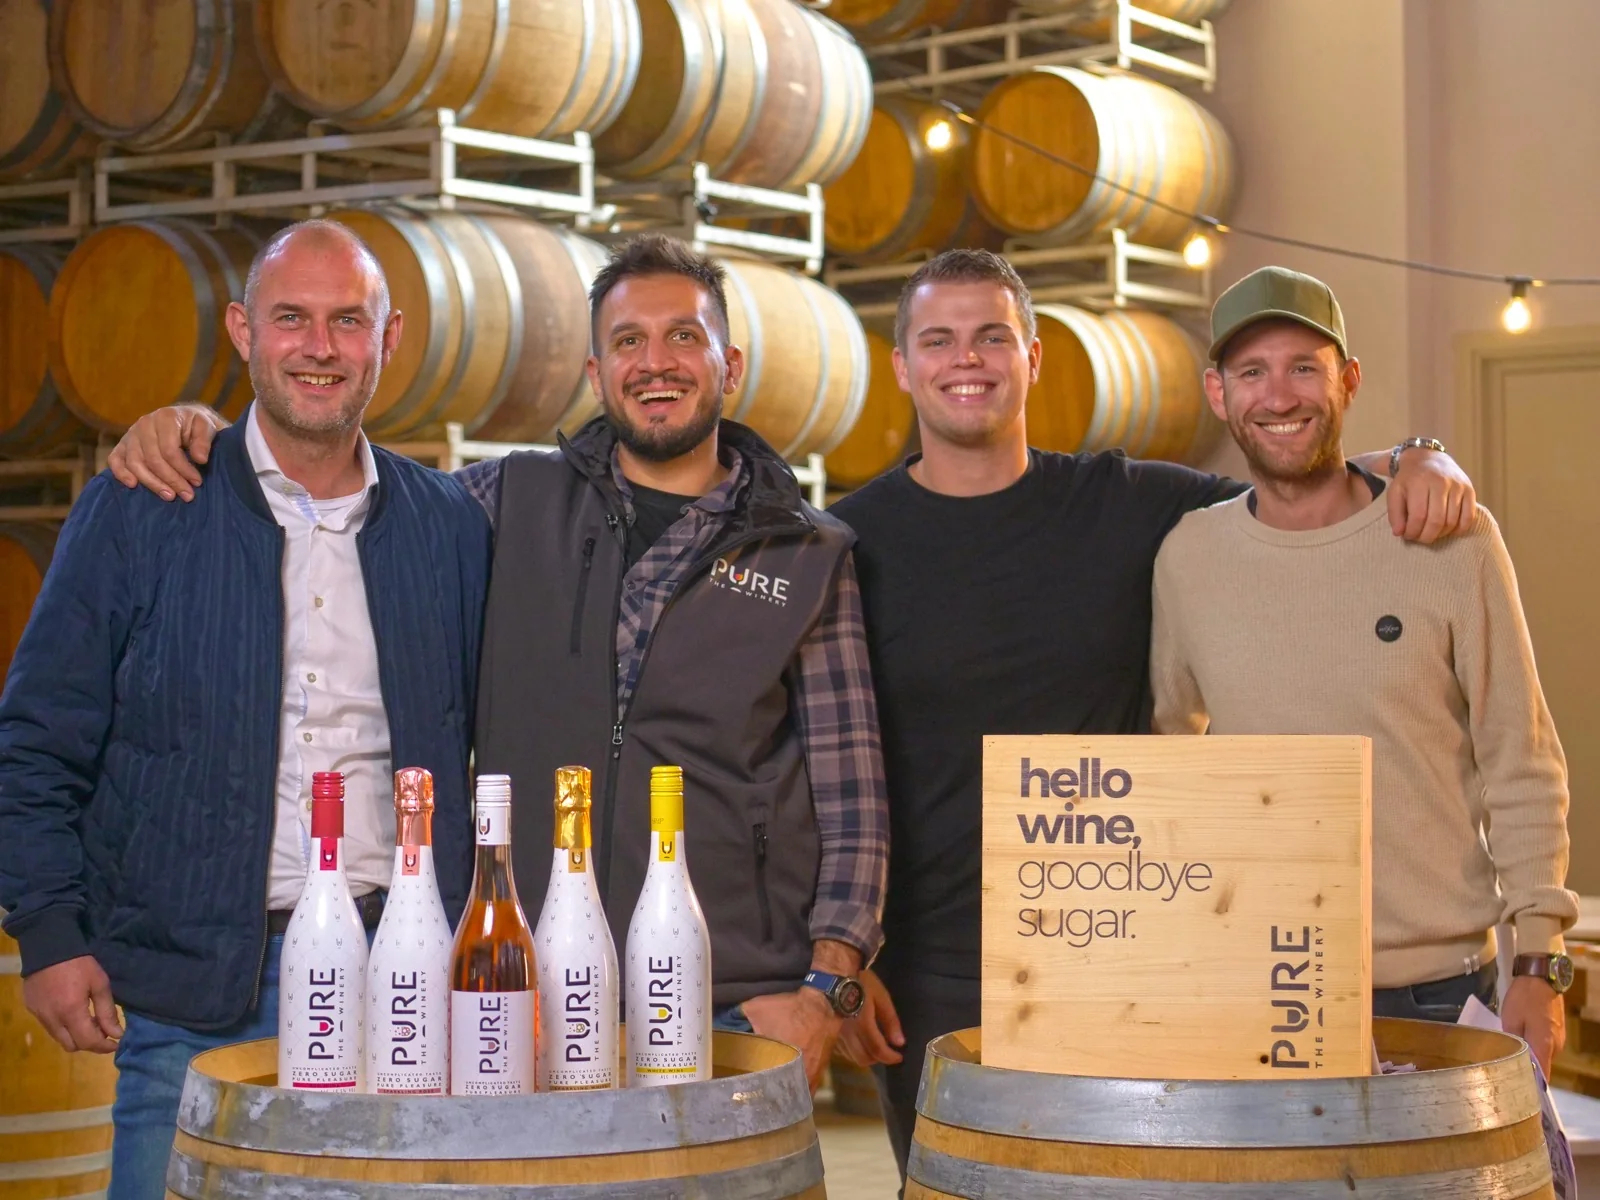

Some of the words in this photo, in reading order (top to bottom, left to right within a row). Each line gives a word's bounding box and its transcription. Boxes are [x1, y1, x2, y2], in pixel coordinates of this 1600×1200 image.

[709, 577, 726, 589] THE
[745, 590, 787, 608] WINERY
[710, 557, 790, 601] PURE
[1020, 757, 1133, 799] hello
[1016, 802, 1142, 849] wine,
[1018, 850, 1213, 902] goodbye
[1017, 908, 1137, 948] sugar.
[1315, 926, 1324, 999] WINERY
[308, 968, 336, 1060] PURE
[391, 971, 417, 1066] PURE
[565, 966, 591, 1063] PURE
[648, 956, 674, 1046] PURE
[1270, 925, 1310, 1069] PURE
[479, 996, 501, 1074] PURE
[1315, 1036, 1324, 1069] THE
[324, 1069, 357, 1077] SUGAR
[407, 1075, 442, 1083] SUGAR
[581, 1071, 612, 1080] SUGAR
